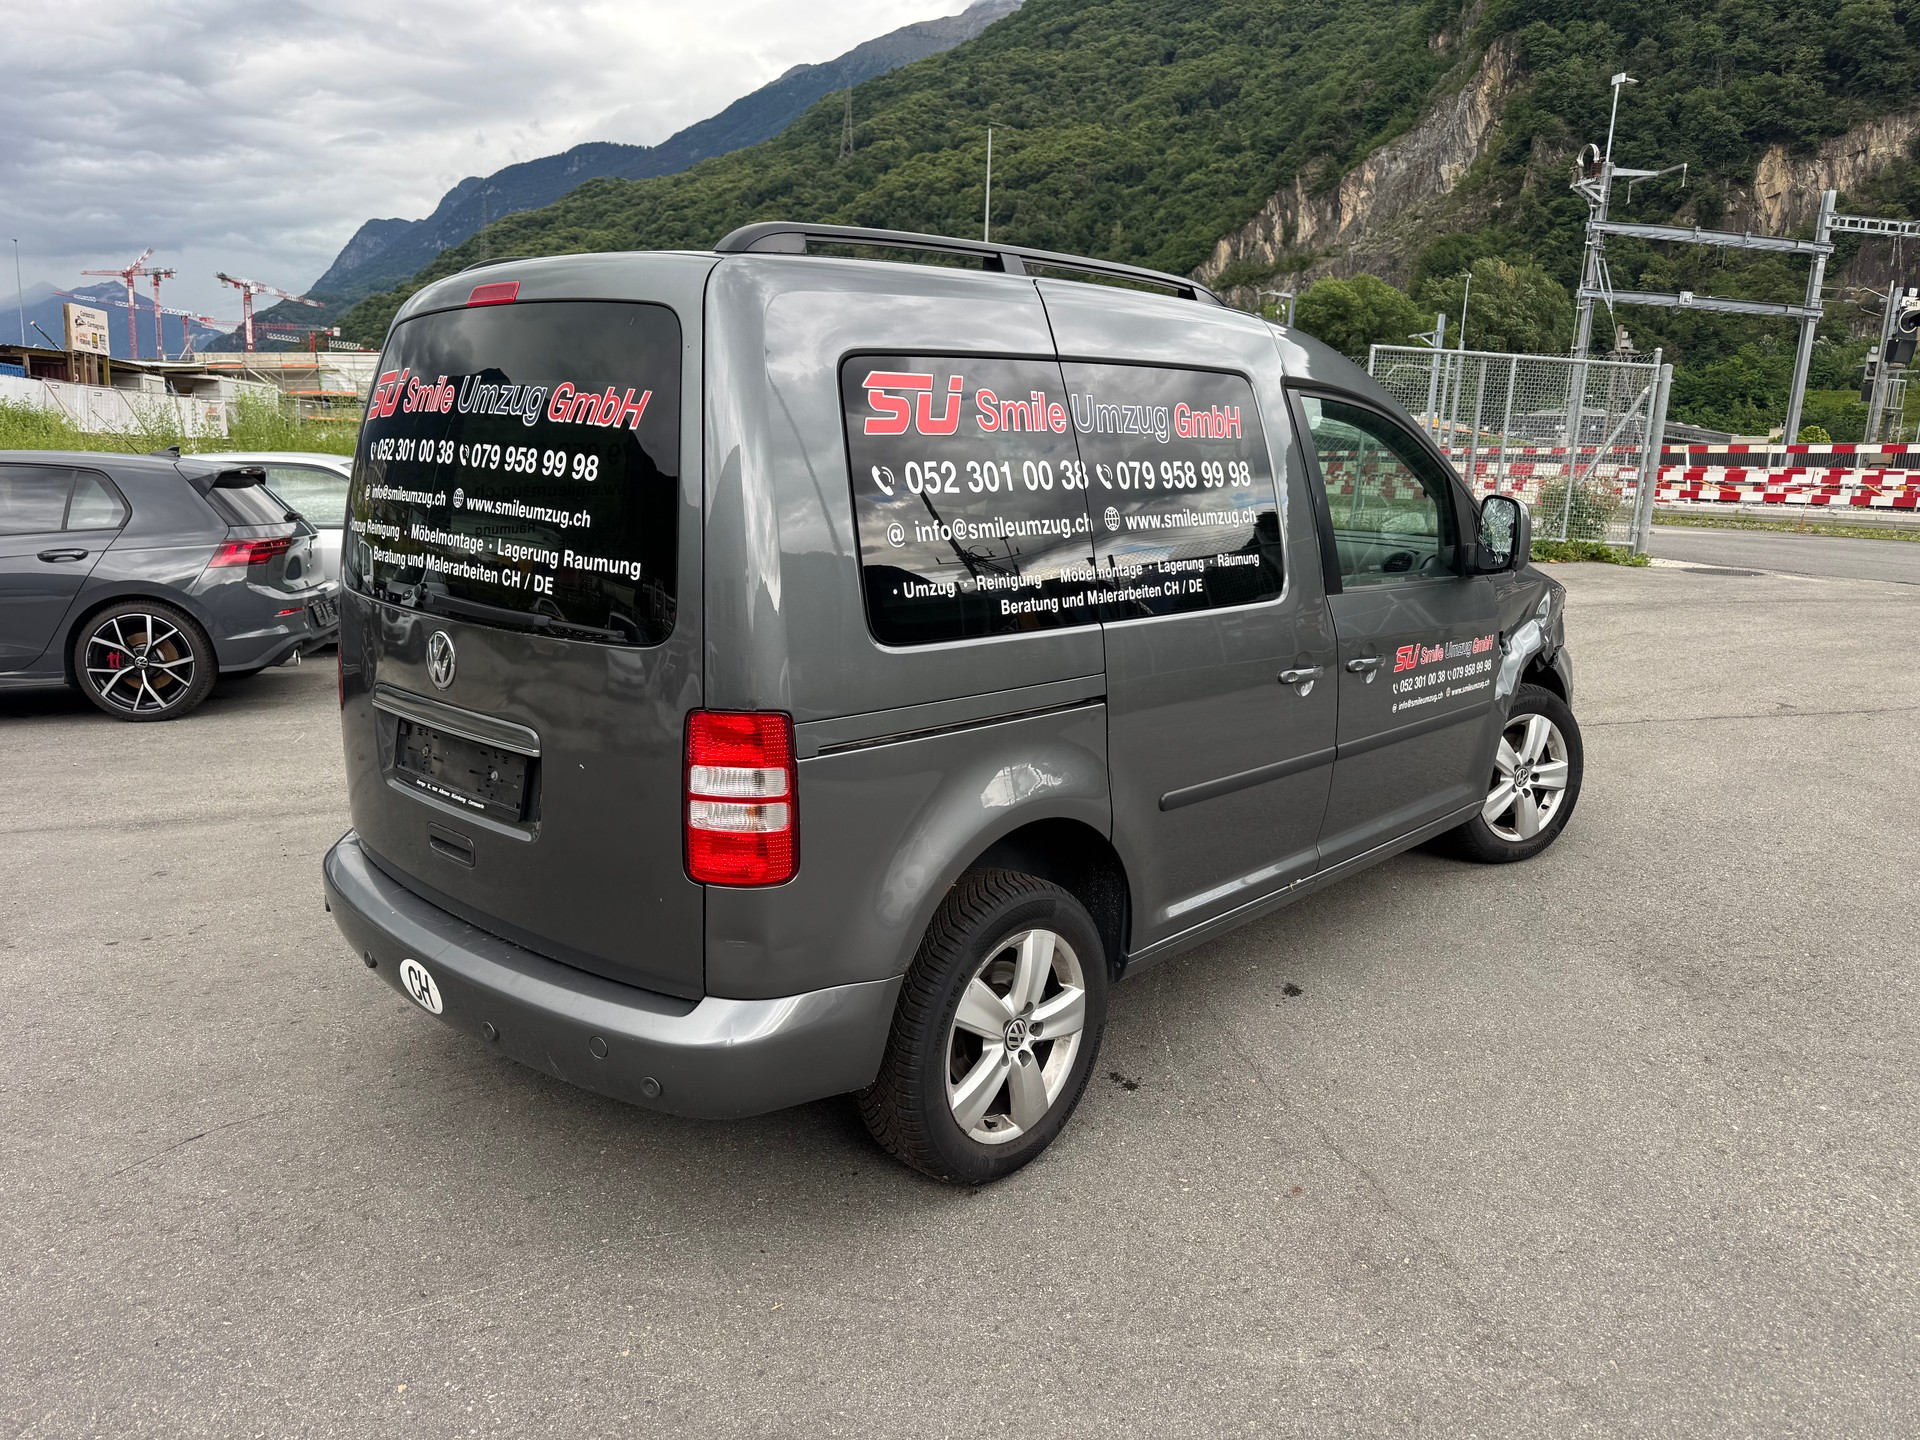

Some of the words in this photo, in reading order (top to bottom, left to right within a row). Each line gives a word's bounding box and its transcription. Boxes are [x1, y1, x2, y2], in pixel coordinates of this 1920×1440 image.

[403, 375, 455, 414] Smile
[457, 375, 548, 427] Umzug
[547, 381, 653, 430] GmbH
[975, 388, 1067, 434] Smile
[1071, 393, 1170, 443] Umzug
[1174, 402, 1242, 439] GmbH
[376, 438, 395, 461] 052
[395, 438, 416, 462] 301
[418, 439, 435, 462] 00
[437, 440, 455, 464] 38
[471, 443, 501, 470] 079
[504, 446, 537, 474] 958
[541, 450, 567, 478] 99
[571, 453, 599, 482] 98
[904, 460, 960, 495] 052
[966, 460, 1014, 492] 301
[1022, 460, 1054, 491] 00
[1060, 460, 1090, 490] 38
[1116, 461, 1156, 490] 079
[1160, 461, 1197, 490] 958
[1201, 461, 1225, 489] 99
[1228, 461, 1251, 488] 98
[371, 483, 447, 509] info@smileumzug.ch
[466, 497, 591, 529] www.smileumzug.ch
[914, 512, 1094, 543] info@smileumzug.ch
[1125, 505, 1257, 531] www.smileumzug.ch
[367, 519, 400, 542] Reinigung
[410, 524, 484, 555] Möbelmontage
[497, 538, 559, 569] Lagerung
[563, 550, 642, 580] Raumung
[373, 545, 406, 569] Beratung
[407, 553, 424, 568] und
[426, 553, 498, 584] Malerarbeiten
[502, 568, 521, 588] CH
[534, 574, 554, 595] DE
[903, 580, 956, 599] Umzug
[976, 572, 1042, 592] Reinigung
[1060, 563, 1143, 583] Möbelmontage
[1157, 557, 1205, 575] Lagerung
[1217, 553, 1260, 568] Räumung
[1001, 596, 1058, 615] Beratung
[1062, 591, 1084, 609] und
[1087, 582, 1161, 606] Malerarbeiten
[1164, 580, 1180, 596] CH
[1189, 578, 1203, 593] DE
[1420, 644, 1444, 665] Smile
[1444, 639, 1473, 659] Umzug
[1472, 634, 1495, 655] GmbH
[1399, 677, 1413, 693] 052
[1413, 675, 1426, 690] 301
[1427, 672, 1436, 686] 00
[1437, 669, 1446, 683] 38
[1452, 666, 1464, 680] 079
[1464, 663, 1476, 677] 958
[1476, 660, 1483, 674] 99
[1484, 658, 1492, 672] 98
[407, 965, 436, 1010] CH
